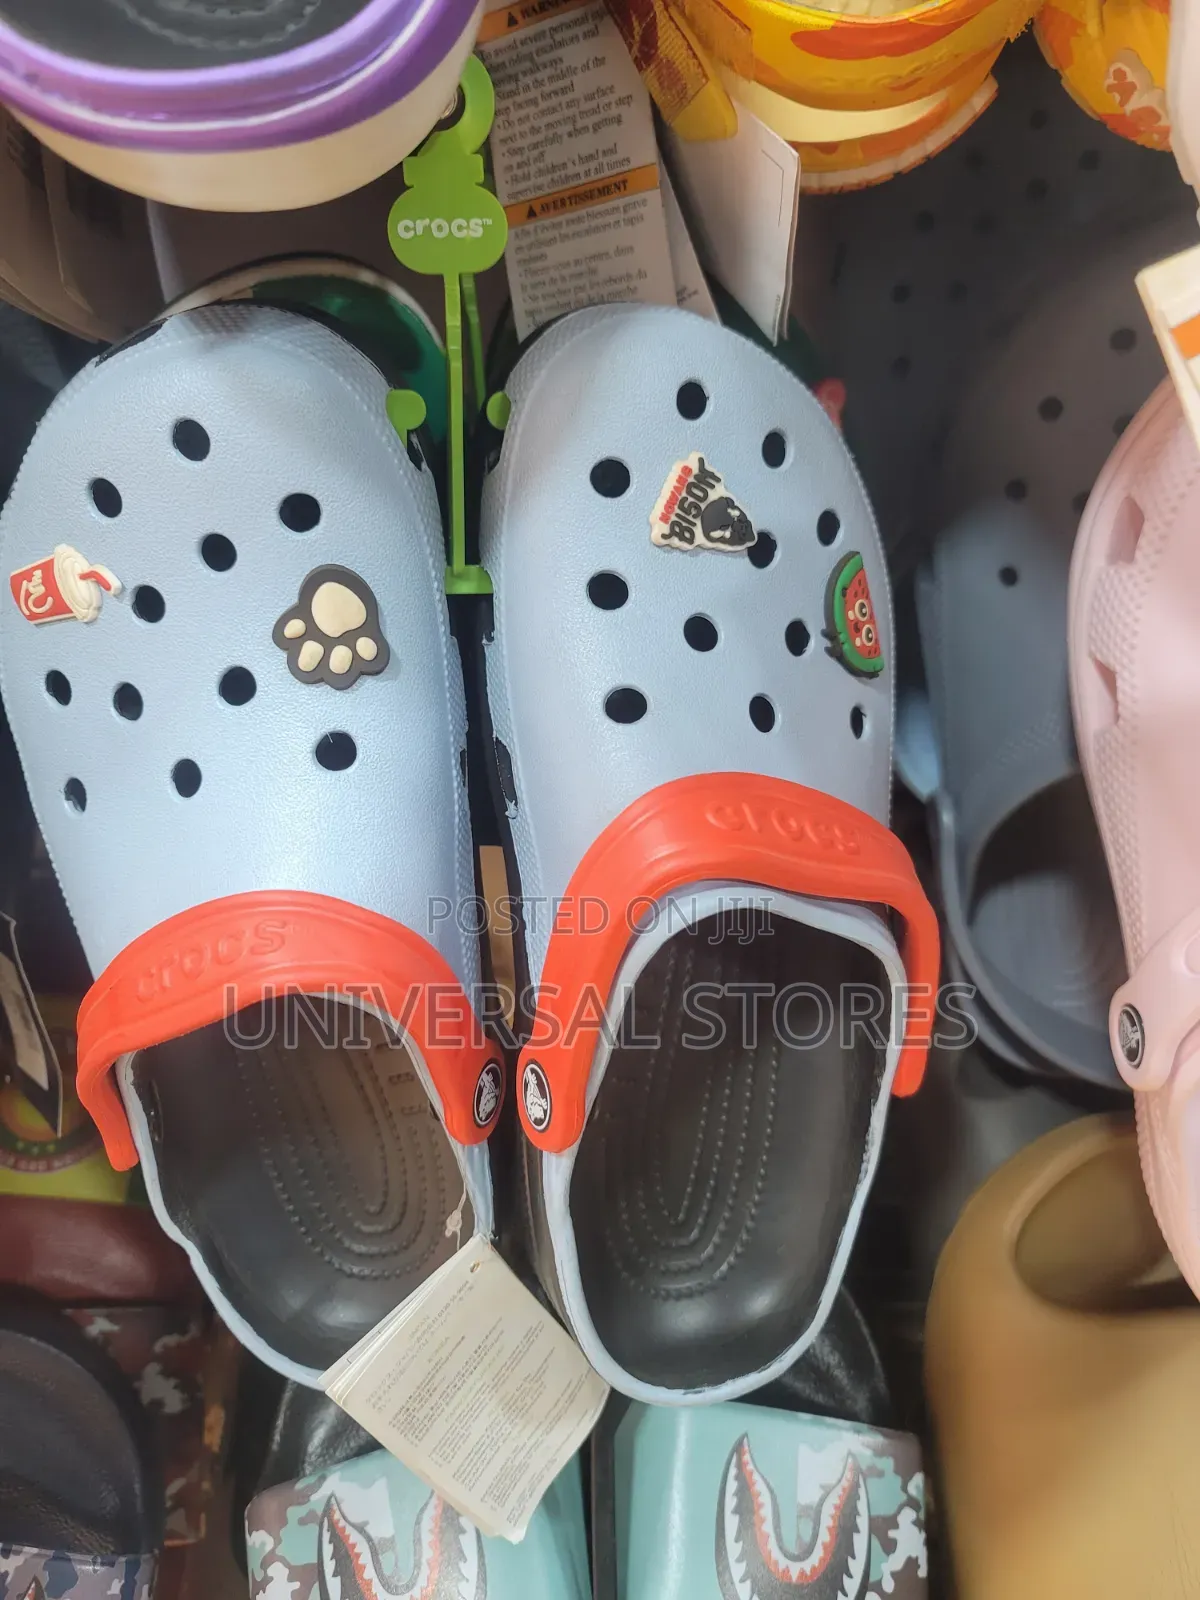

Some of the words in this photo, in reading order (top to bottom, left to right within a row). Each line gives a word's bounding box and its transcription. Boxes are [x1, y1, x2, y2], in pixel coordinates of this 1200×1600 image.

[548, 12, 589, 40] personal
[582, 24, 599, 40] and
[532, 77, 545, 89] the
[546, 65, 578, 84] middle
[580, 59, 590, 73] of
[592, 56, 606, 69] the
[517, 113, 530, 127] not
[532, 101, 563, 121] contact
[565, 98, 580, 112] any
[582, 84, 616, 104] surface
[541, 80, 575, 102] forward
[529, 124, 542, 136] the
[543, 113, 577, 132] moving
[578, 102, 601, 120] tread
[614, 93, 633, 109] step
[526, 131, 563, 152] carefully
[591, 113, 623, 135] getting
[516, 155, 531, 170] and
[577, 148, 599, 165] hand
[601, 142, 618, 158] and
[546, 172, 582, 190] children
[593, 160, 605, 176] all
[606, 156, 631, 171] times
[539, 179, 628, 216] AVERTISSEMENT
[622, 197, 648, 215] grave
[660, 456, 722, 546] BISON
